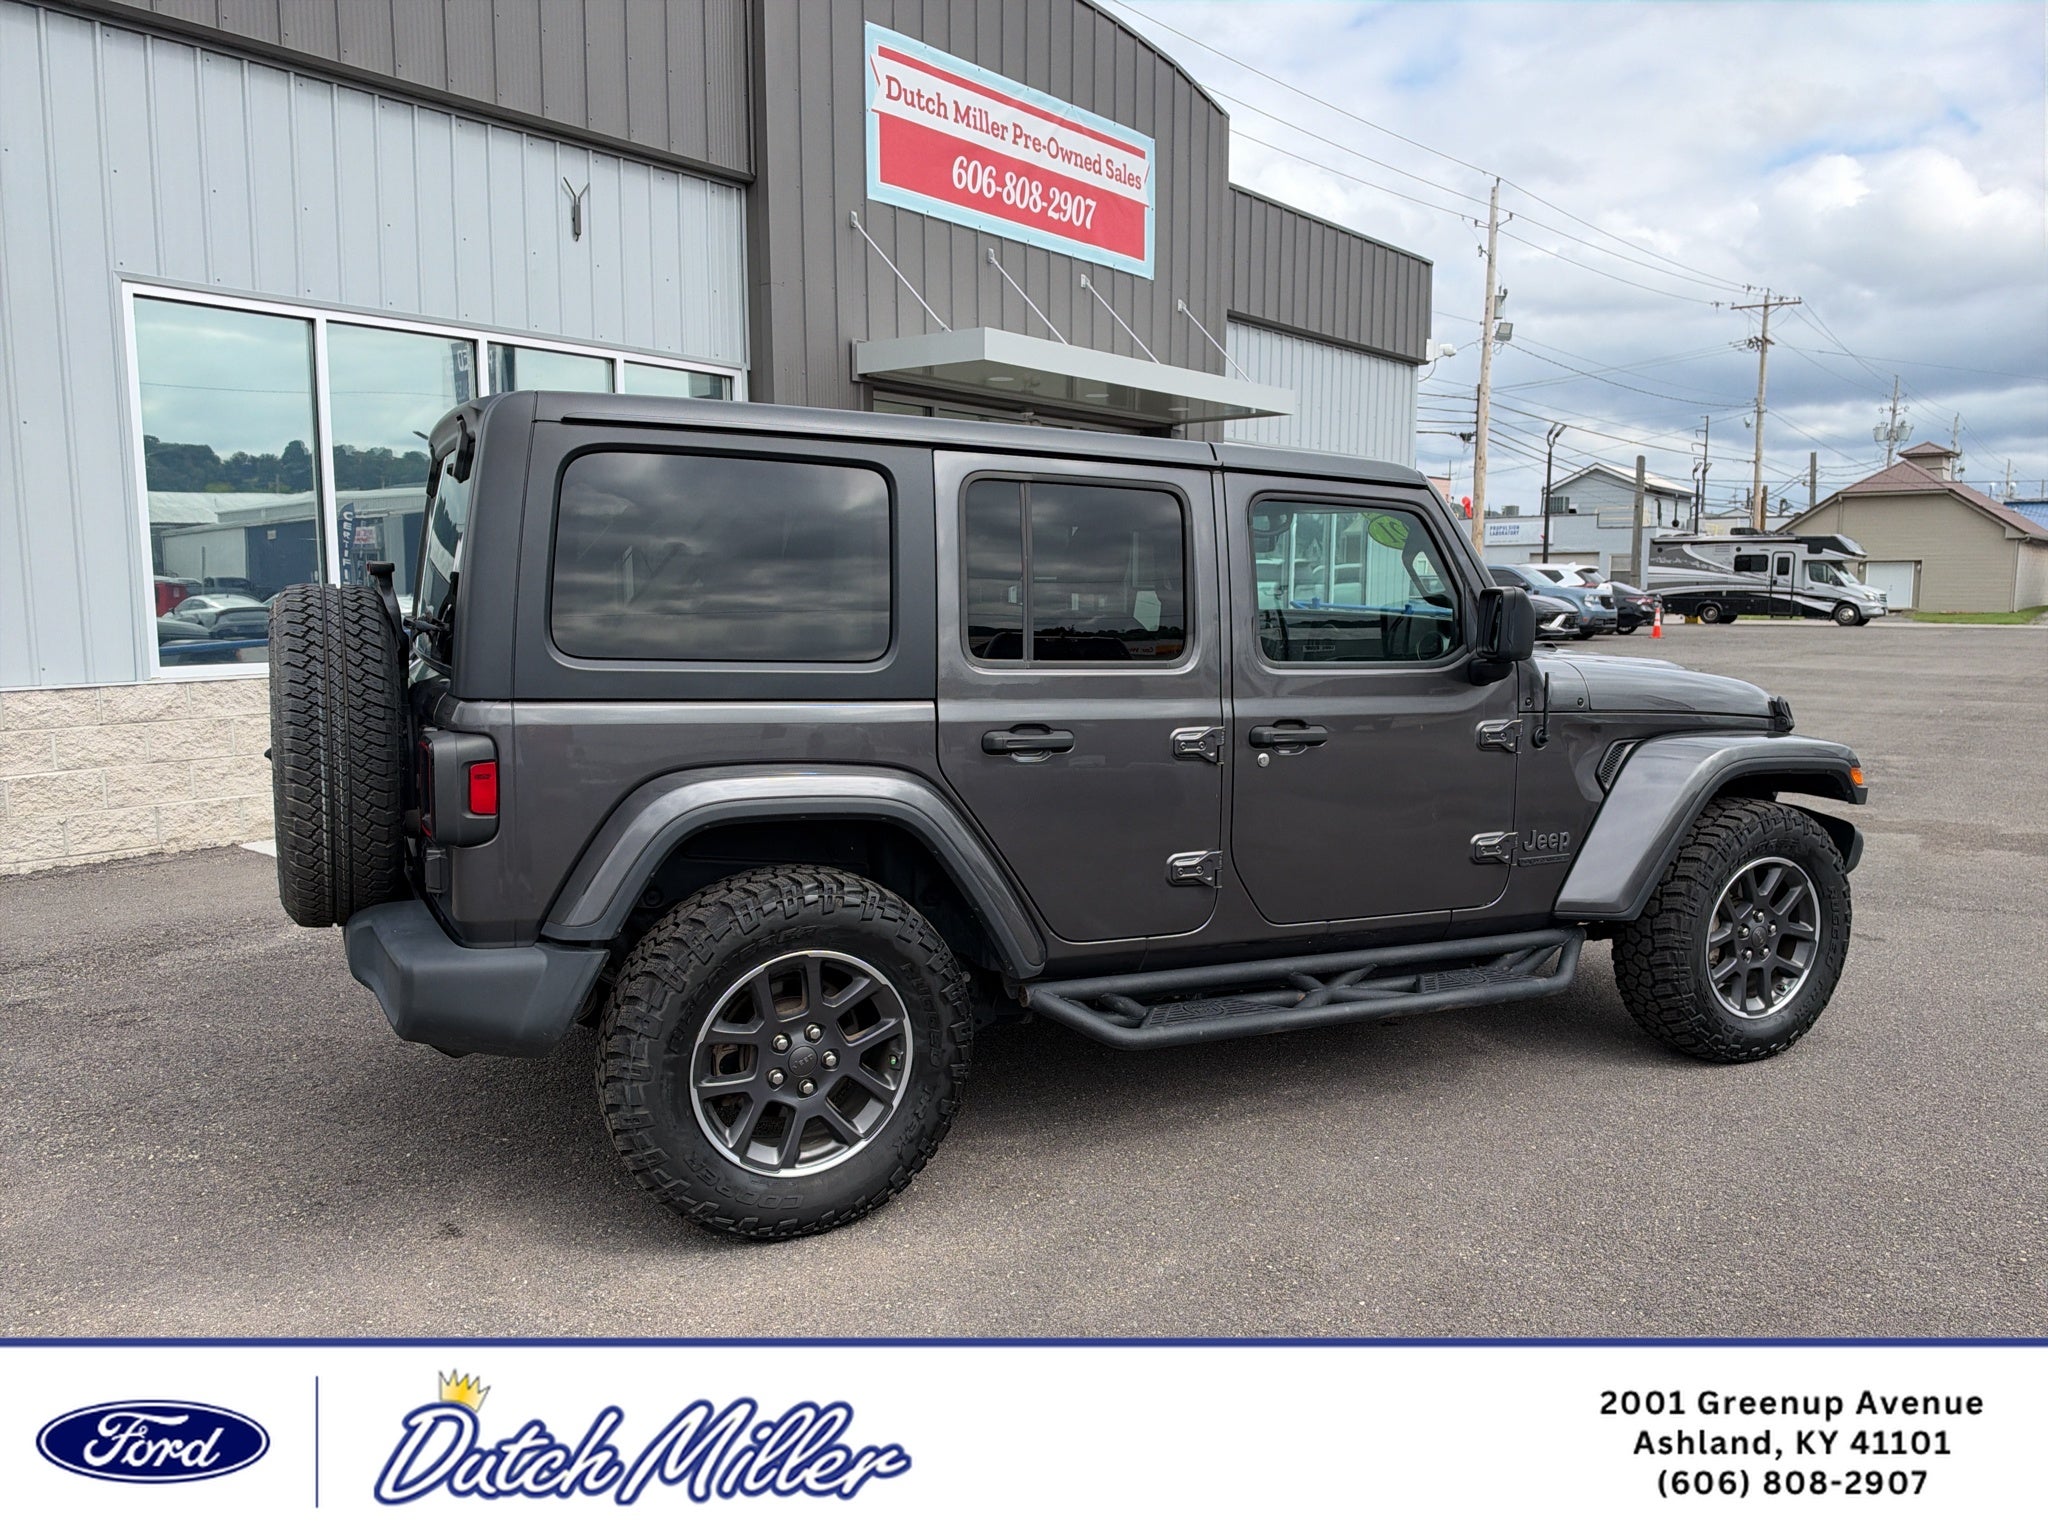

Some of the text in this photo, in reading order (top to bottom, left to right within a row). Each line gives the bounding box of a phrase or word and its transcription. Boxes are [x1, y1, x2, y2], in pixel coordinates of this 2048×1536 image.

[885, 75, 1142, 190] Dutch Miller Pre-Owned Sales
[951, 155, 1097, 230] 606-808-2907
[1523, 829, 1571, 852] Jeep
